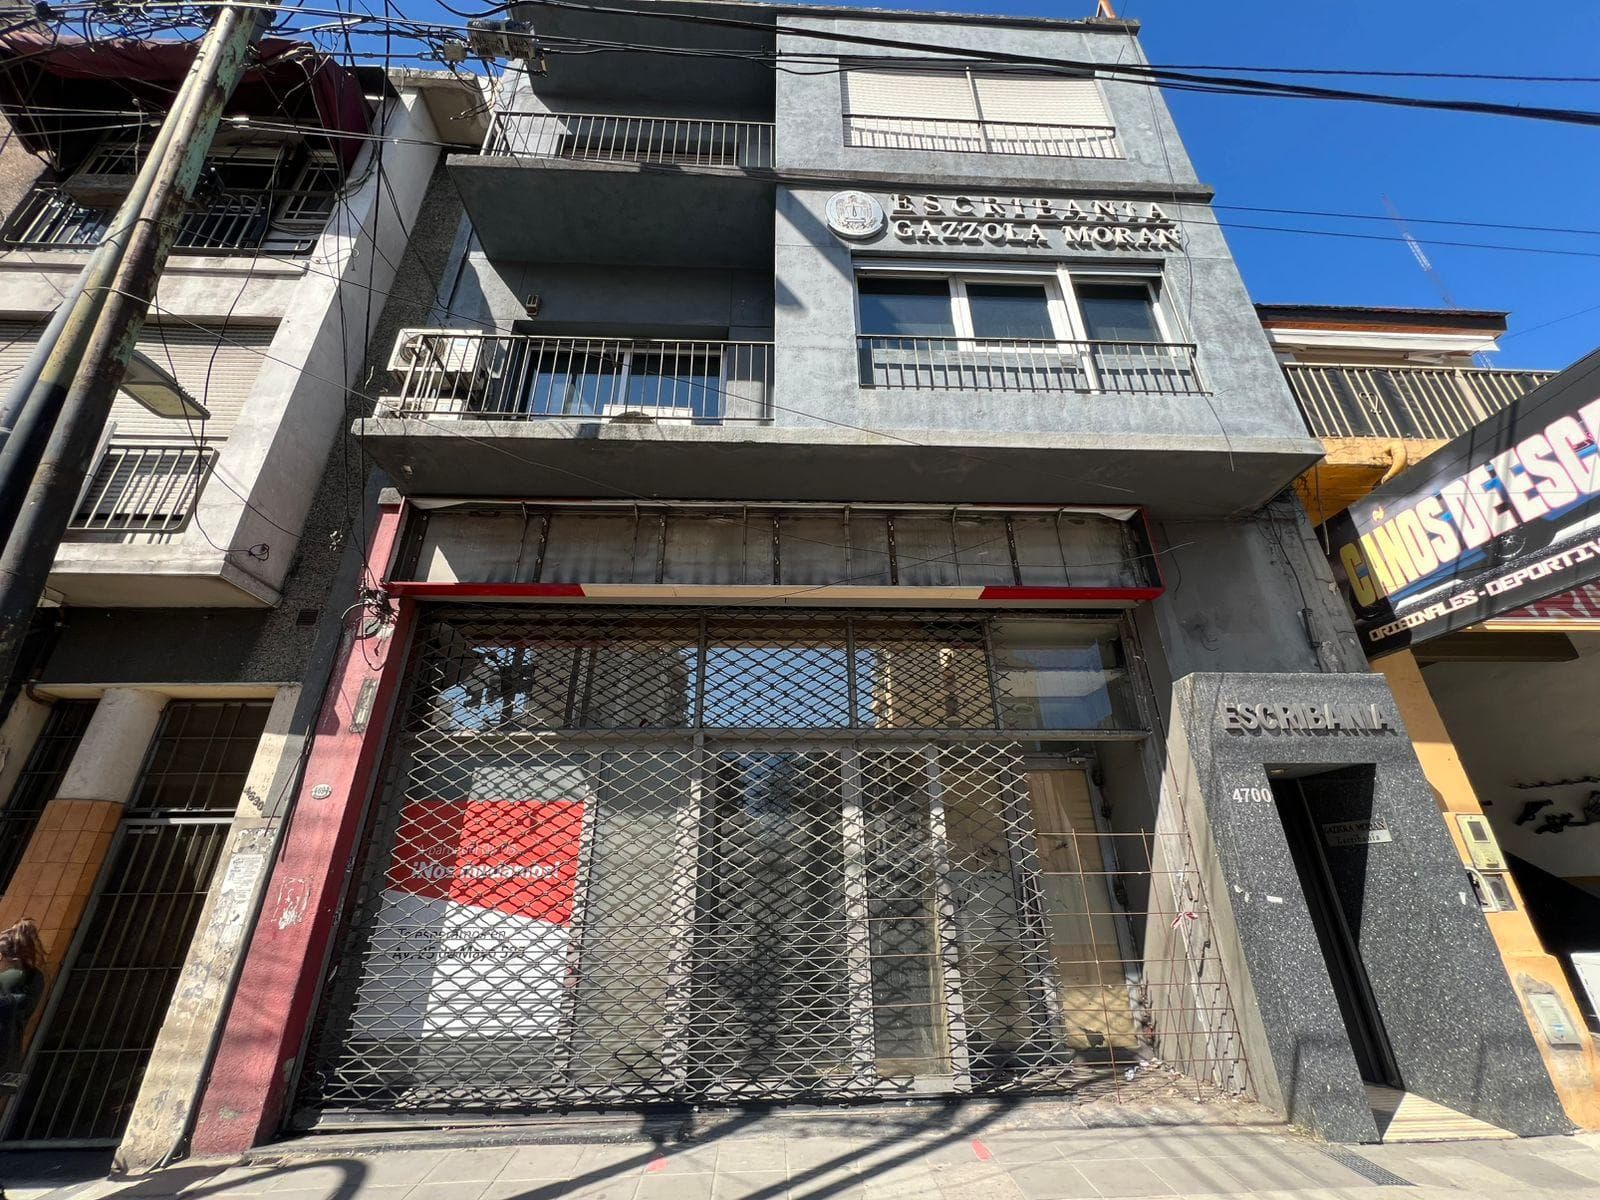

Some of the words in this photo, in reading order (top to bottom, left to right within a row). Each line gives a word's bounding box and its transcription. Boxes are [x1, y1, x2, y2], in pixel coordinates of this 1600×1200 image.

[891, 193, 1173, 223] ESCRIBANIA
[893, 219, 1049, 247] GAZZOLA
[1440, 464, 1520, 550] DE
[1223, 702, 1395, 735] ESCRIBANIA
[1232, 787, 1272, 803] 4700
